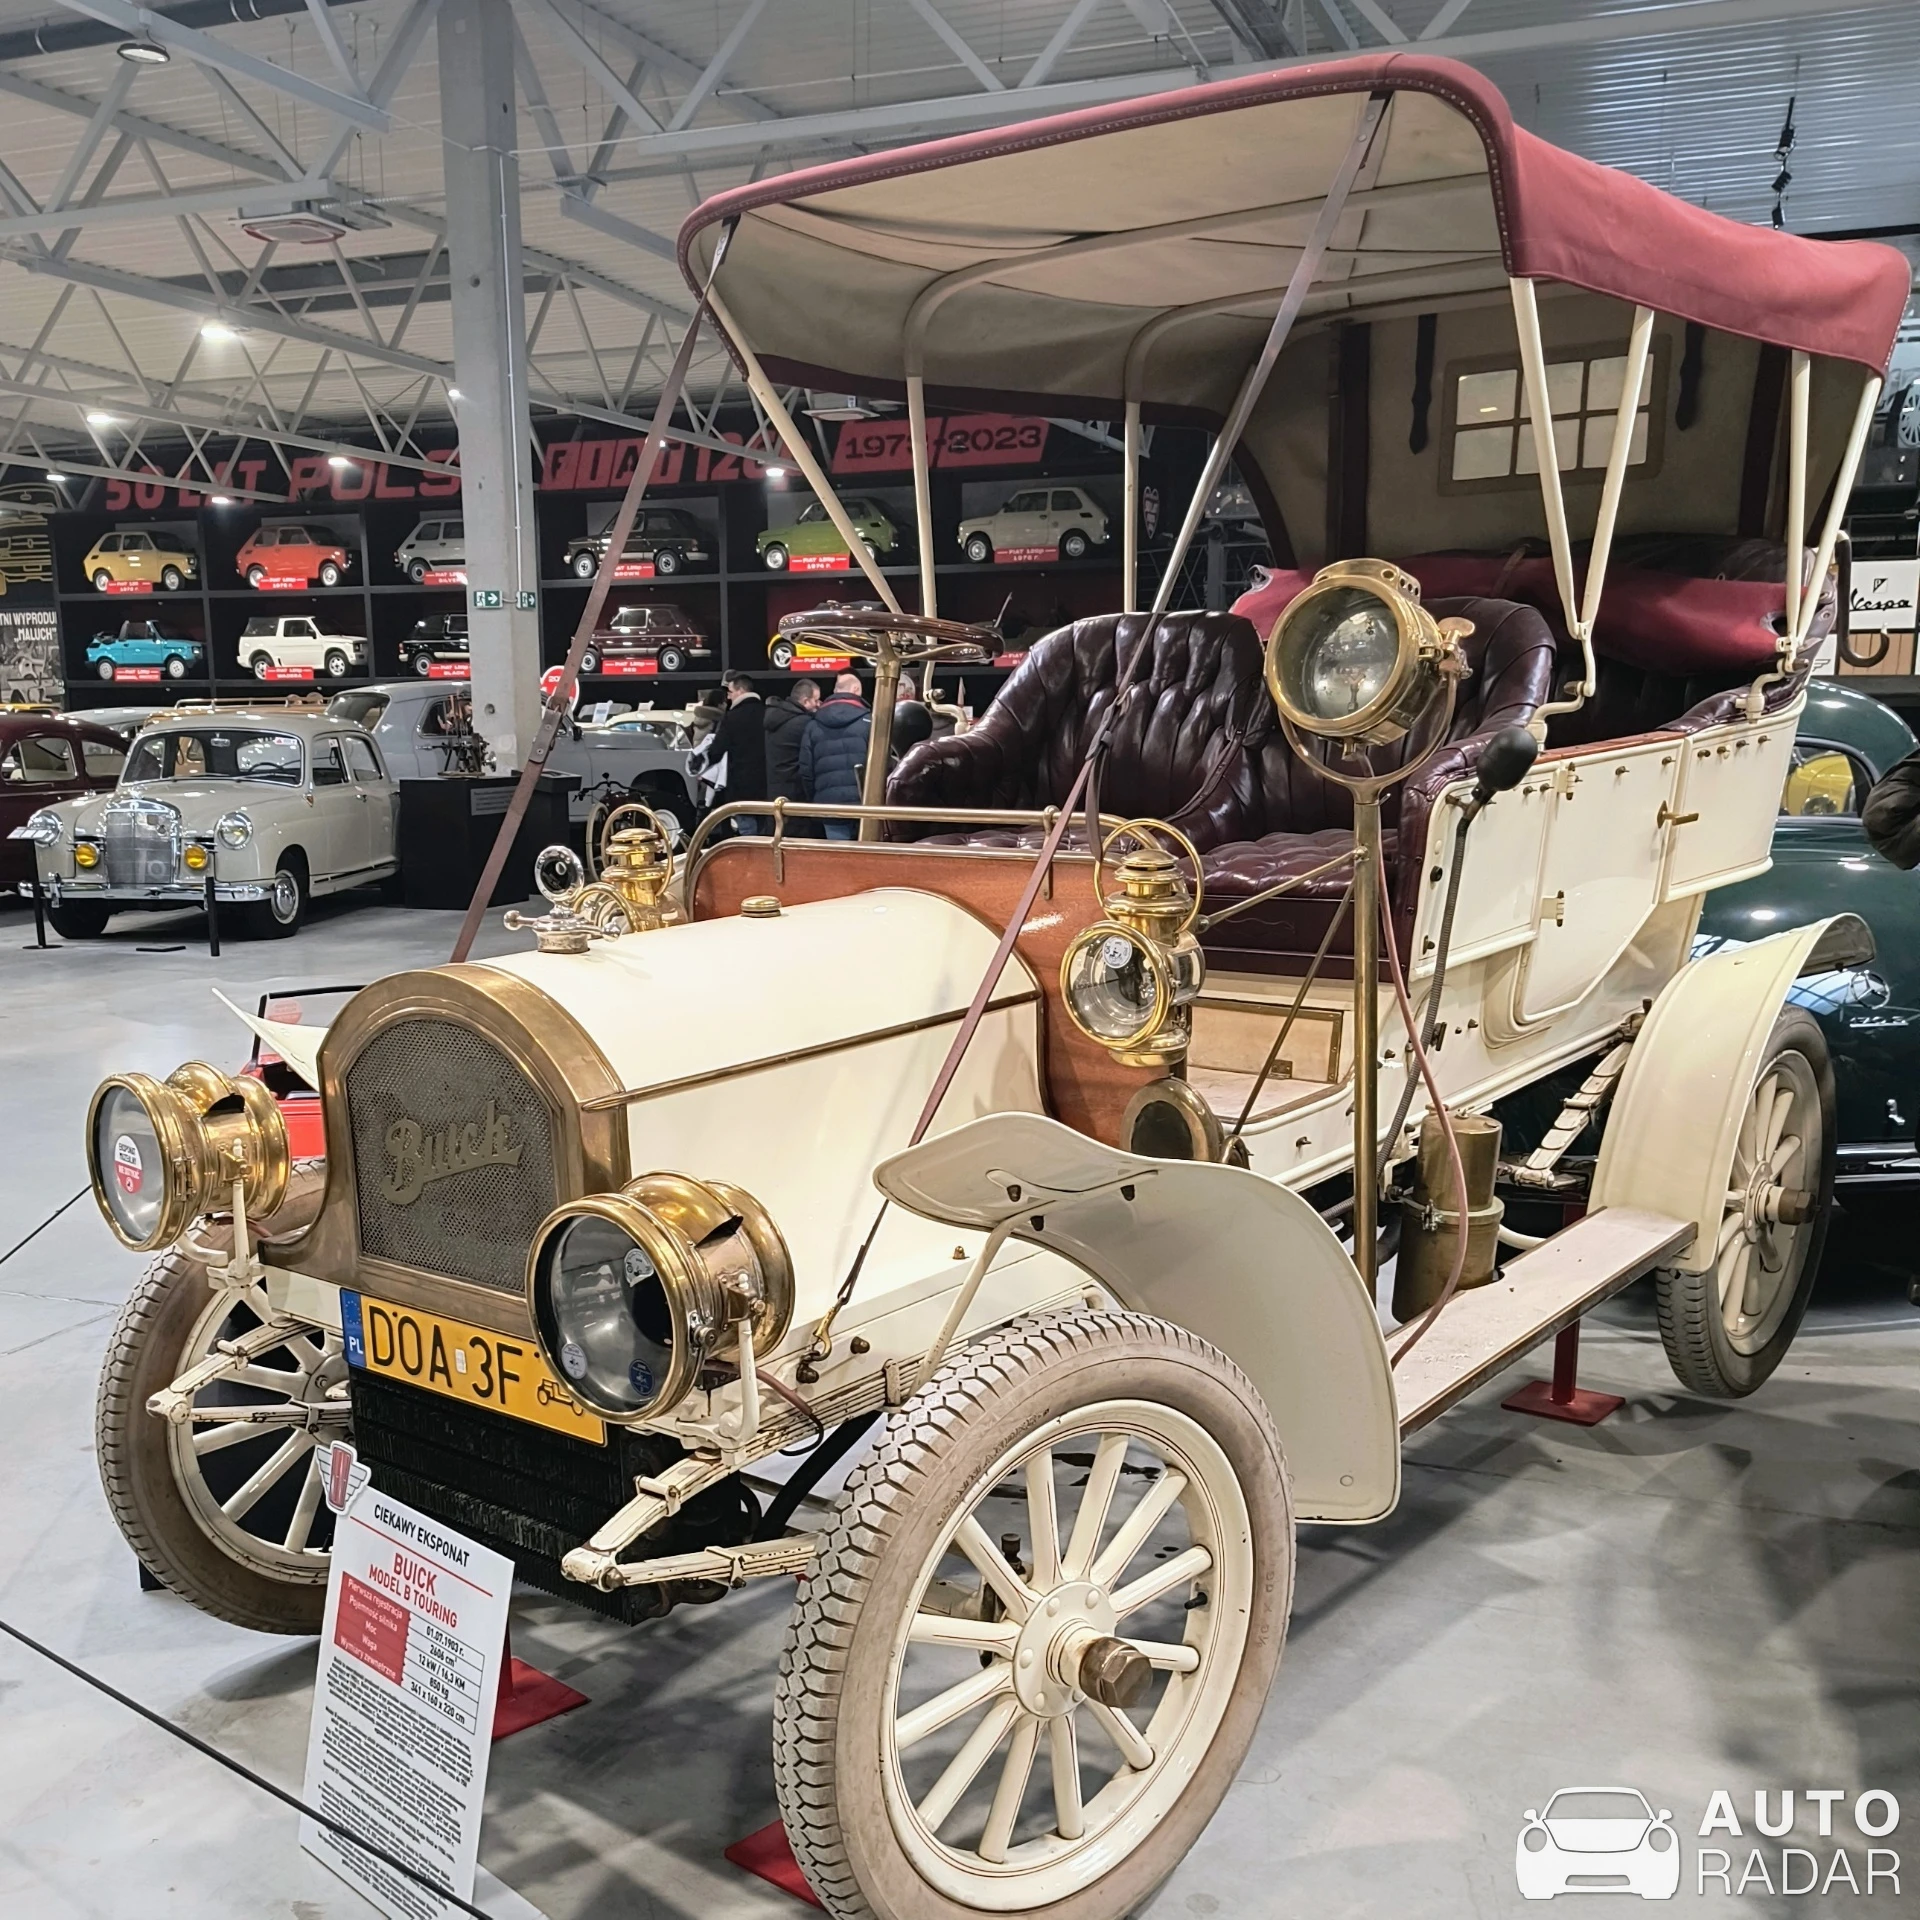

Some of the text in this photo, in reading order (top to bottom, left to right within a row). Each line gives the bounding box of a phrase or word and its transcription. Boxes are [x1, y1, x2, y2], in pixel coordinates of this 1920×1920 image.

[845, 426, 1042, 459] 197-2023
[106, 466, 165, 511] 50
[288, 449, 461, 503] POLS
[548, 437, 683, 482] FIAT
[1850, 588, 1913, 611] Vespa
[0, 611, 57, 625] TNI WYPRODU
[380, 1100, 523, 1205] Buick
[349, 1336, 363, 1354] PL
[369, 1305, 452, 1388] DOA
[469, 1336, 522, 1404] 3F
[374, 1504, 470, 1567] CIEKAWY EKSPONAT
[394, 1552, 438, 1596] BUICK
[348, 1579, 403, 1620] Pierwsza rejestracja
[369, 1564, 458, 1628] MODEL B TOURING
[362, 1634, 378, 1650] Waga
[365, 1621, 377, 1635] Moc
[340, 1636, 364, 1661] Wymiary
[418, 1654, 426, 1665] 12
[425, 1657, 436, 1674] kW
[455, 1676, 465, 1690] KM
[440, 1684, 449, 1699] kg
[454, 1712, 465, 1725] cm
